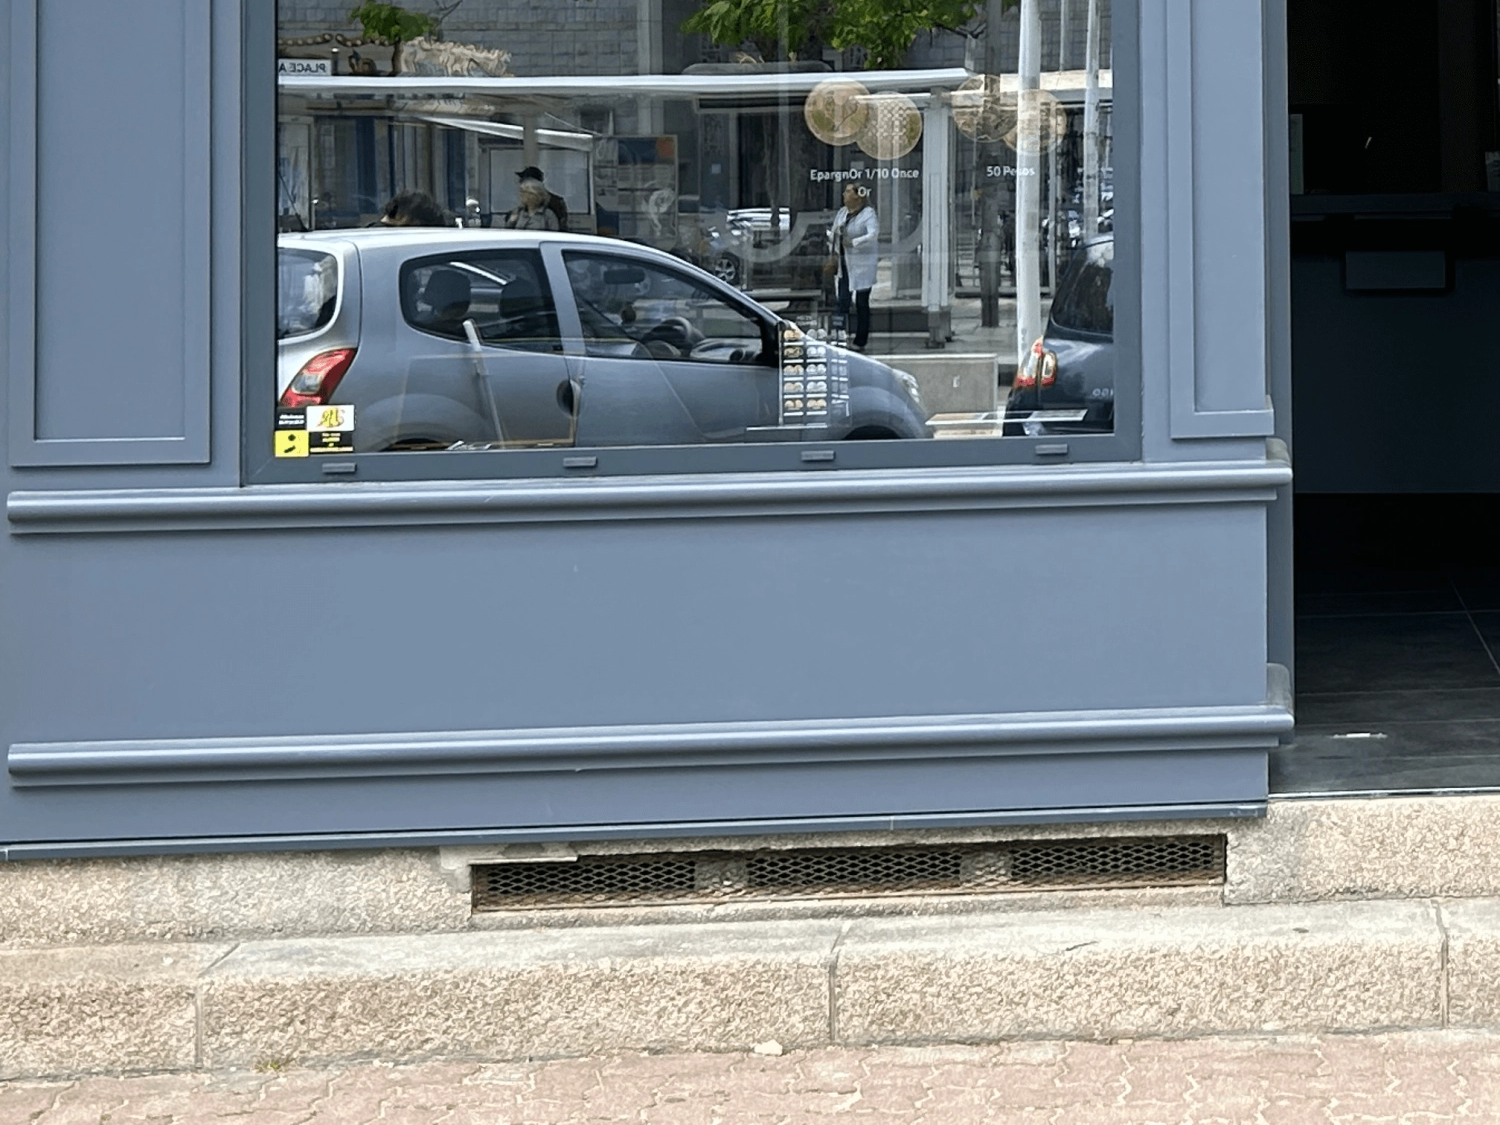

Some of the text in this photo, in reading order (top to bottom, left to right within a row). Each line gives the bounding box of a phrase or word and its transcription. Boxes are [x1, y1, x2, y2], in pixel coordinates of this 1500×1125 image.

[865, 168, 890, 180] 1/10
[892, 168, 919, 179] Once
[987, 167, 1001, 176] 50
[858, 186, 872, 197] Or
